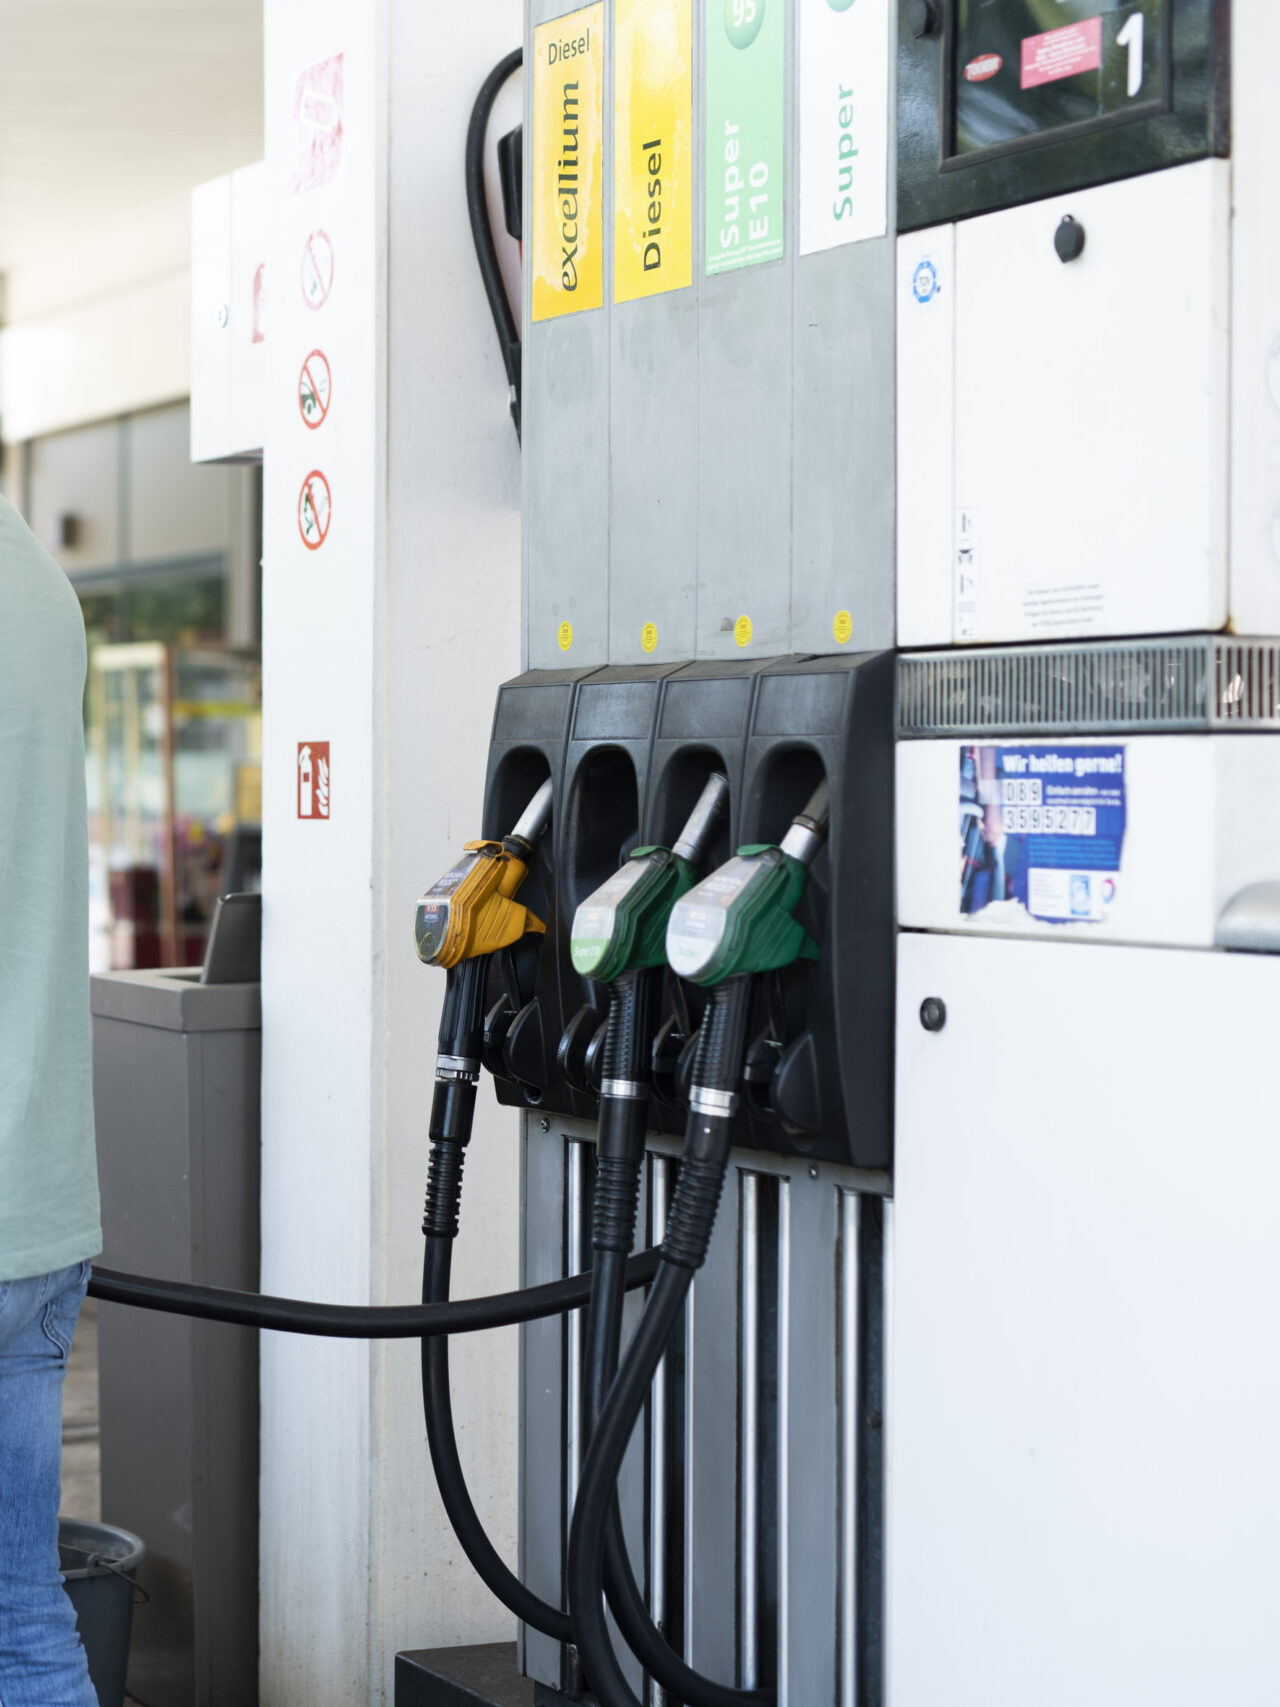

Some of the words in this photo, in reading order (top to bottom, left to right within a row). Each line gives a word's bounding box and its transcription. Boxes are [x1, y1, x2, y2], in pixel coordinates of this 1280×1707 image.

[548, 28, 590, 66] Diesel
[1116, 12, 1144, 97] 1
[556, 80, 580, 292] excellium
[643, 139, 662, 272] Diesel
[720, 120, 745, 248] Super
[748, 161, 769, 242] E10
[833, 84, 859, 221] Super
[1002, 754, 1028, 773] Wir
